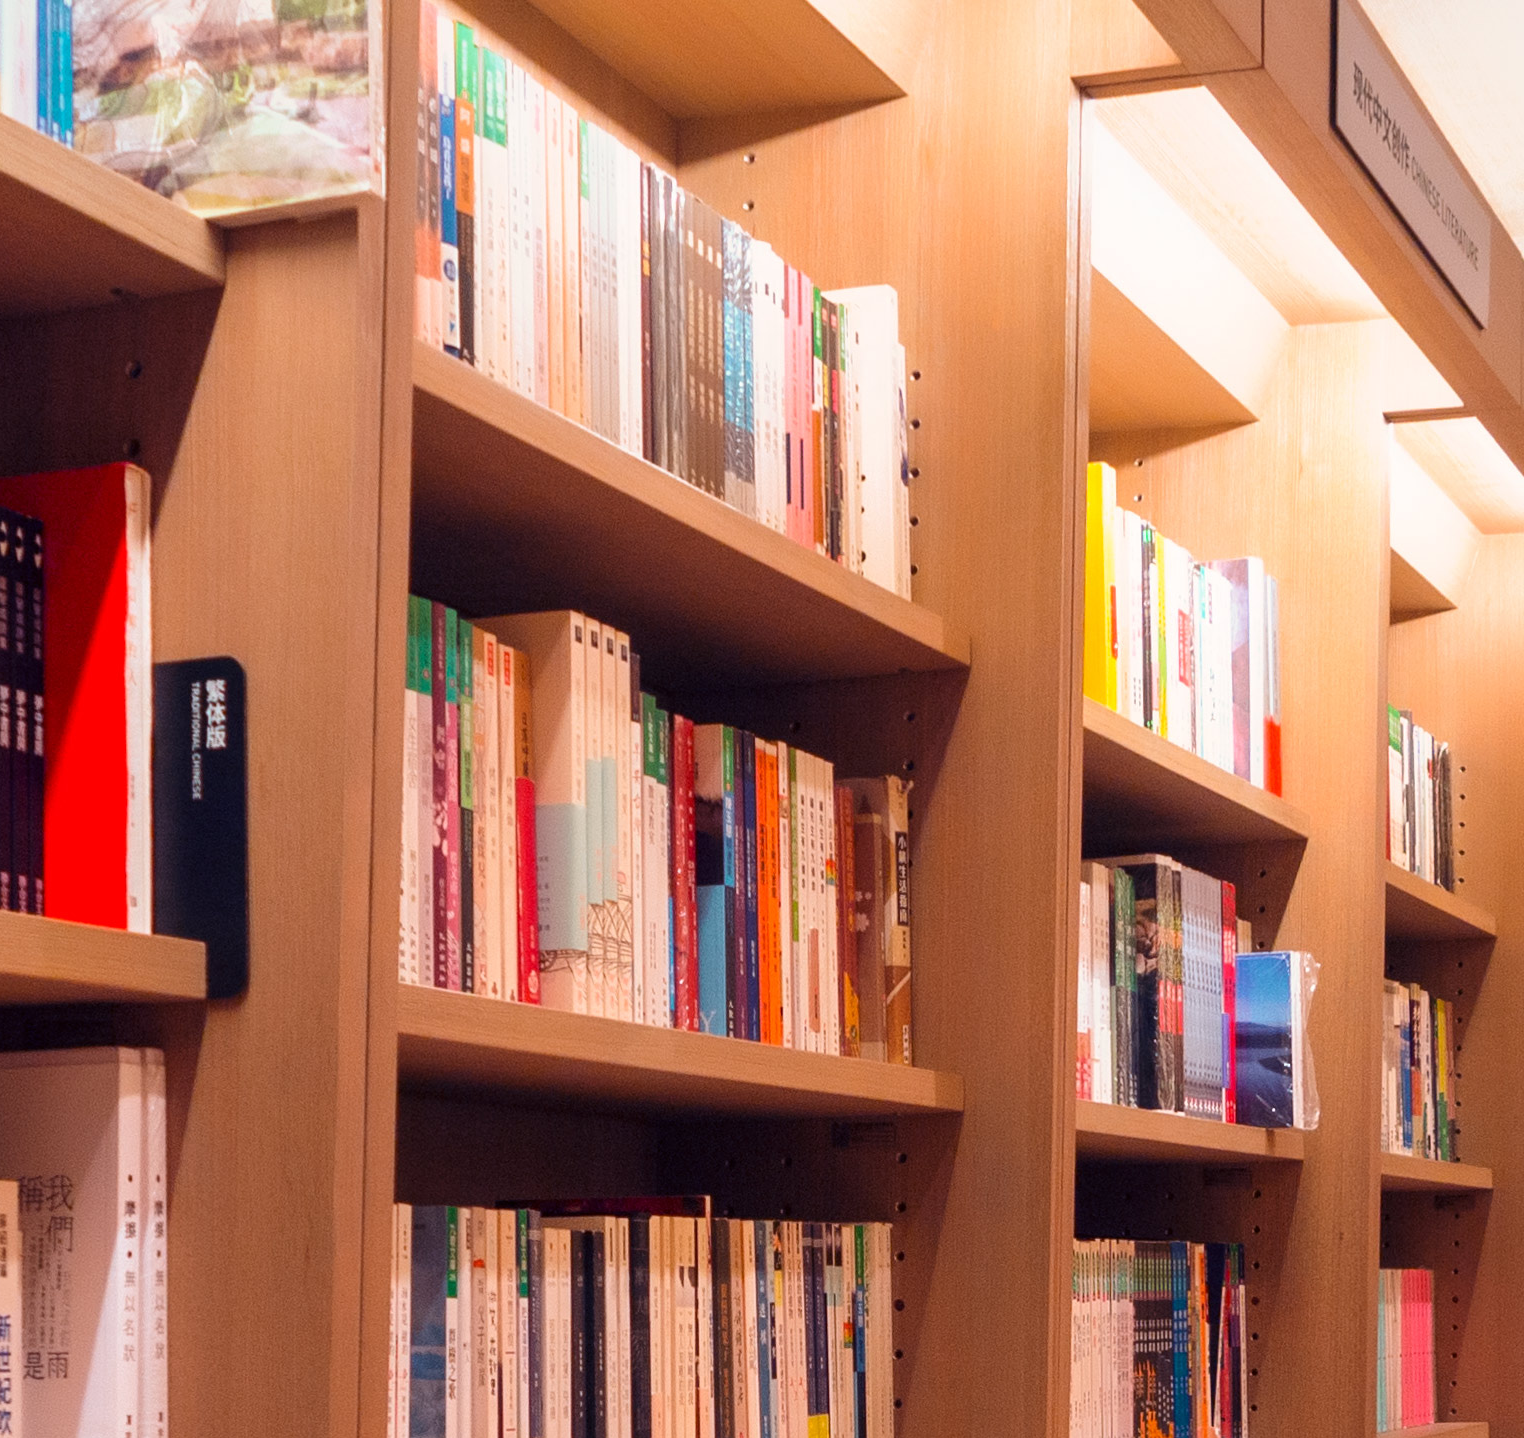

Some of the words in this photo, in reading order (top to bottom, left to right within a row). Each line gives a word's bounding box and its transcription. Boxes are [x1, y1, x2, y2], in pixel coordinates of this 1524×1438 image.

[1352, 61, 1412, 176] 现代中文创作
[1410, 155, 1442, 217] CHINESE
[1439, 193, 1481, 273] LITERATURE
[191, 681, 202, 751] TRADITIONAL
[205, 678, 228, 750] 繁体版
[191, 753, 204, 801] CHINESE
[45, 1174, 74, 1253] 我們
[24, 1351, 47, 1381] 是
[46, 1350, 70, 1380] 雨
